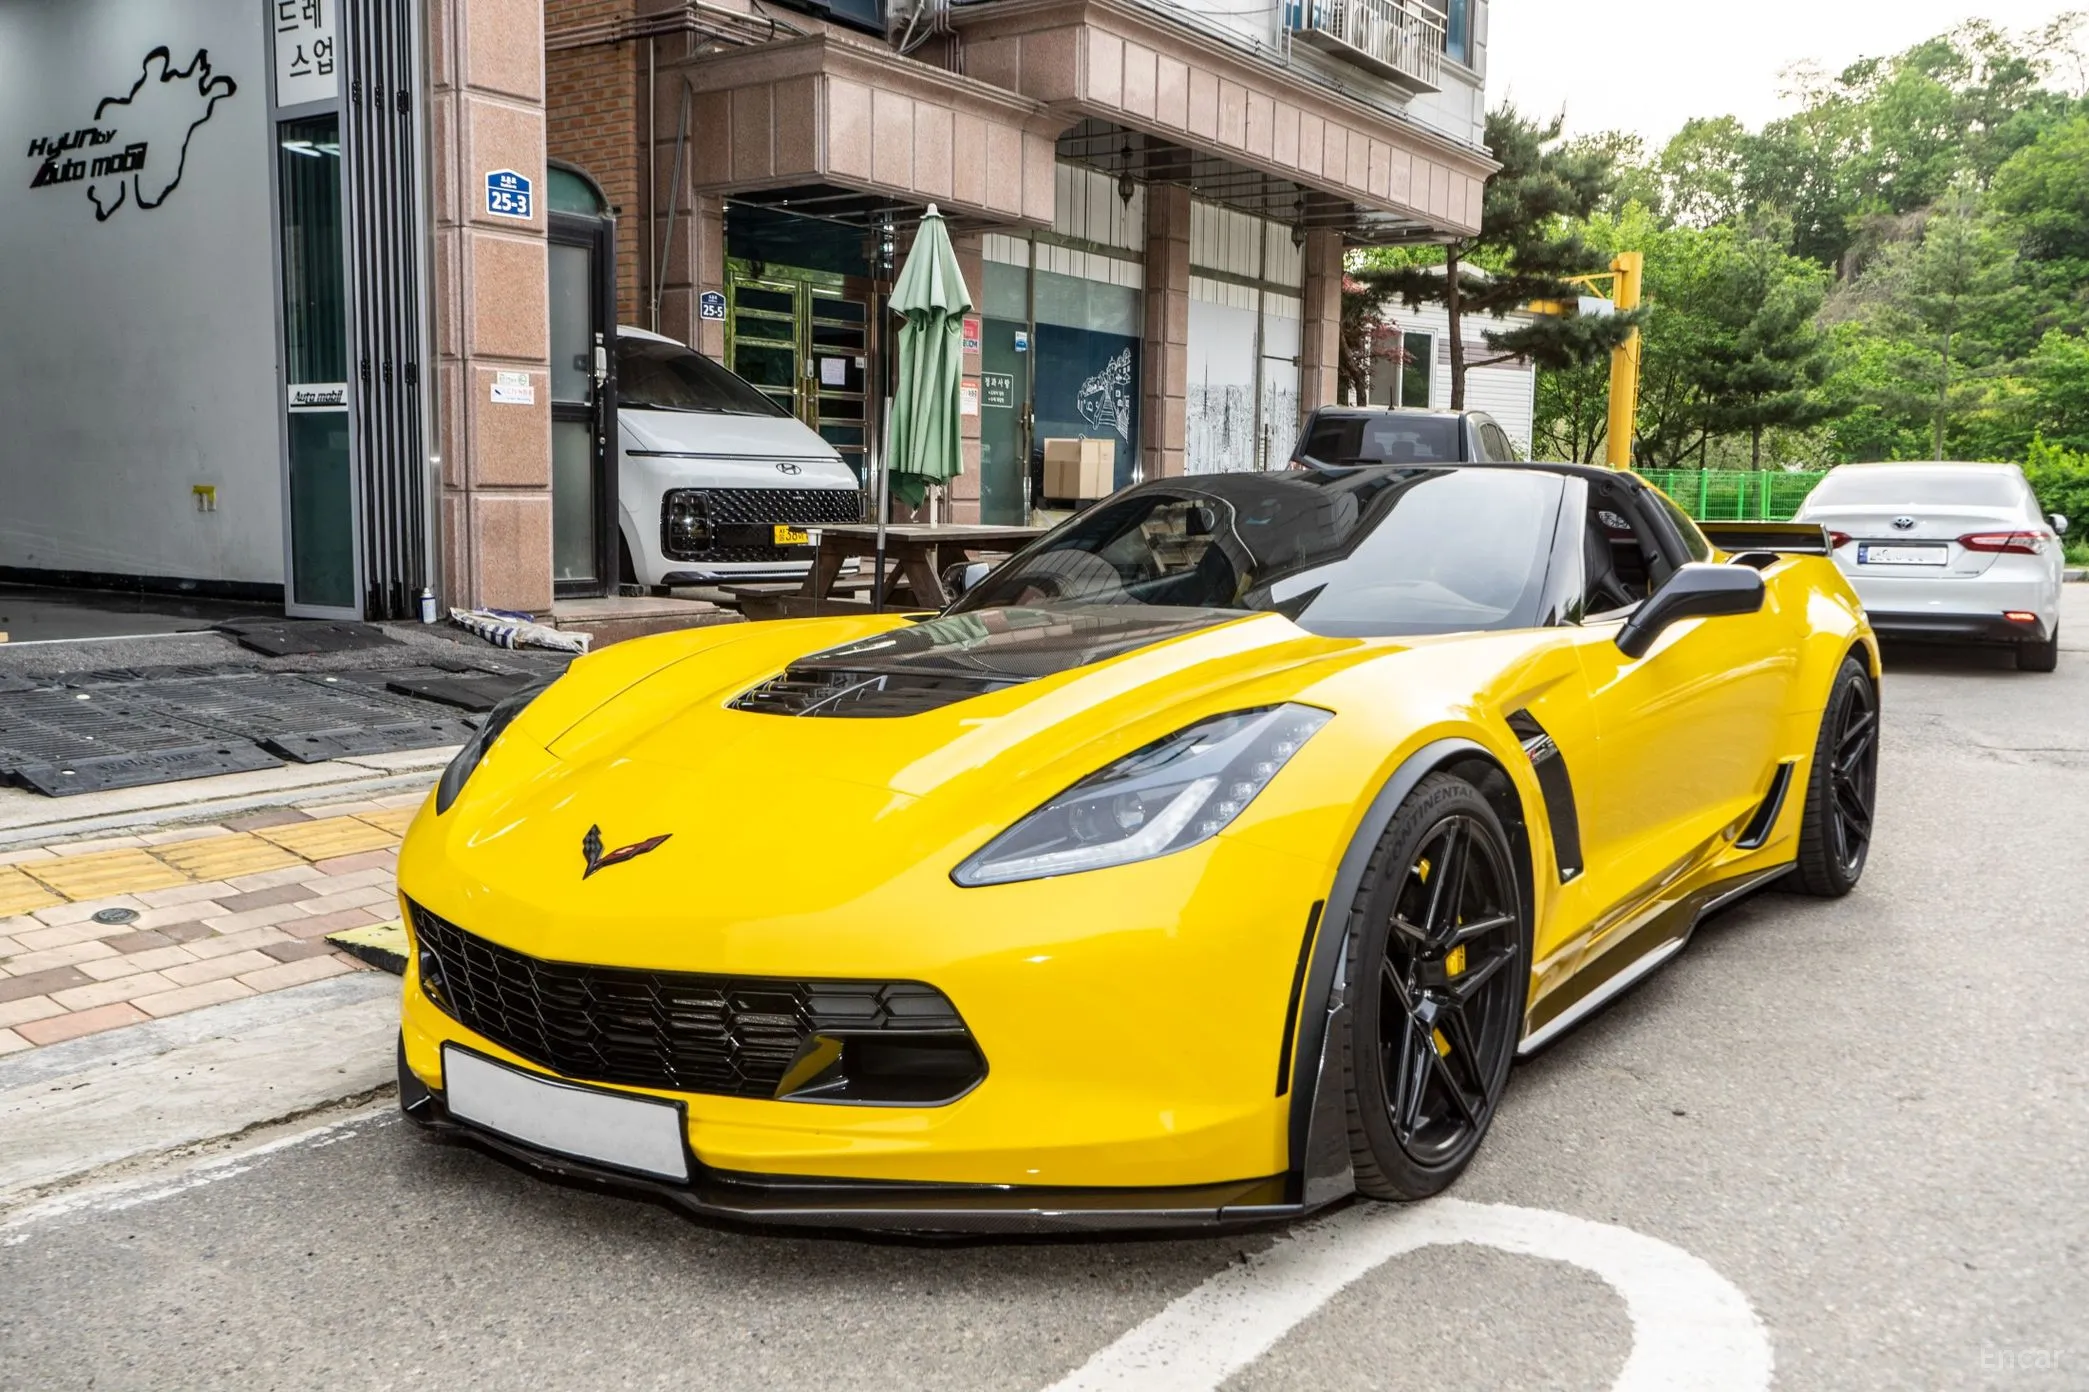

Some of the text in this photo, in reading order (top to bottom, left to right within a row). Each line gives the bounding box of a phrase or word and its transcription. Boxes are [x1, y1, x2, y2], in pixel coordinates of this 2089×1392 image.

[278, 0, 322, 32] 드레
[289, 36, 334, 77] 스업
[97, 129, 118, 145] by
[29, 158, 87, 188] Auto
[491, 191, 527, 213] 25-3
[703, 304, 723, 317] 25-5
[293, 390, 343, 403] Auto mobil
